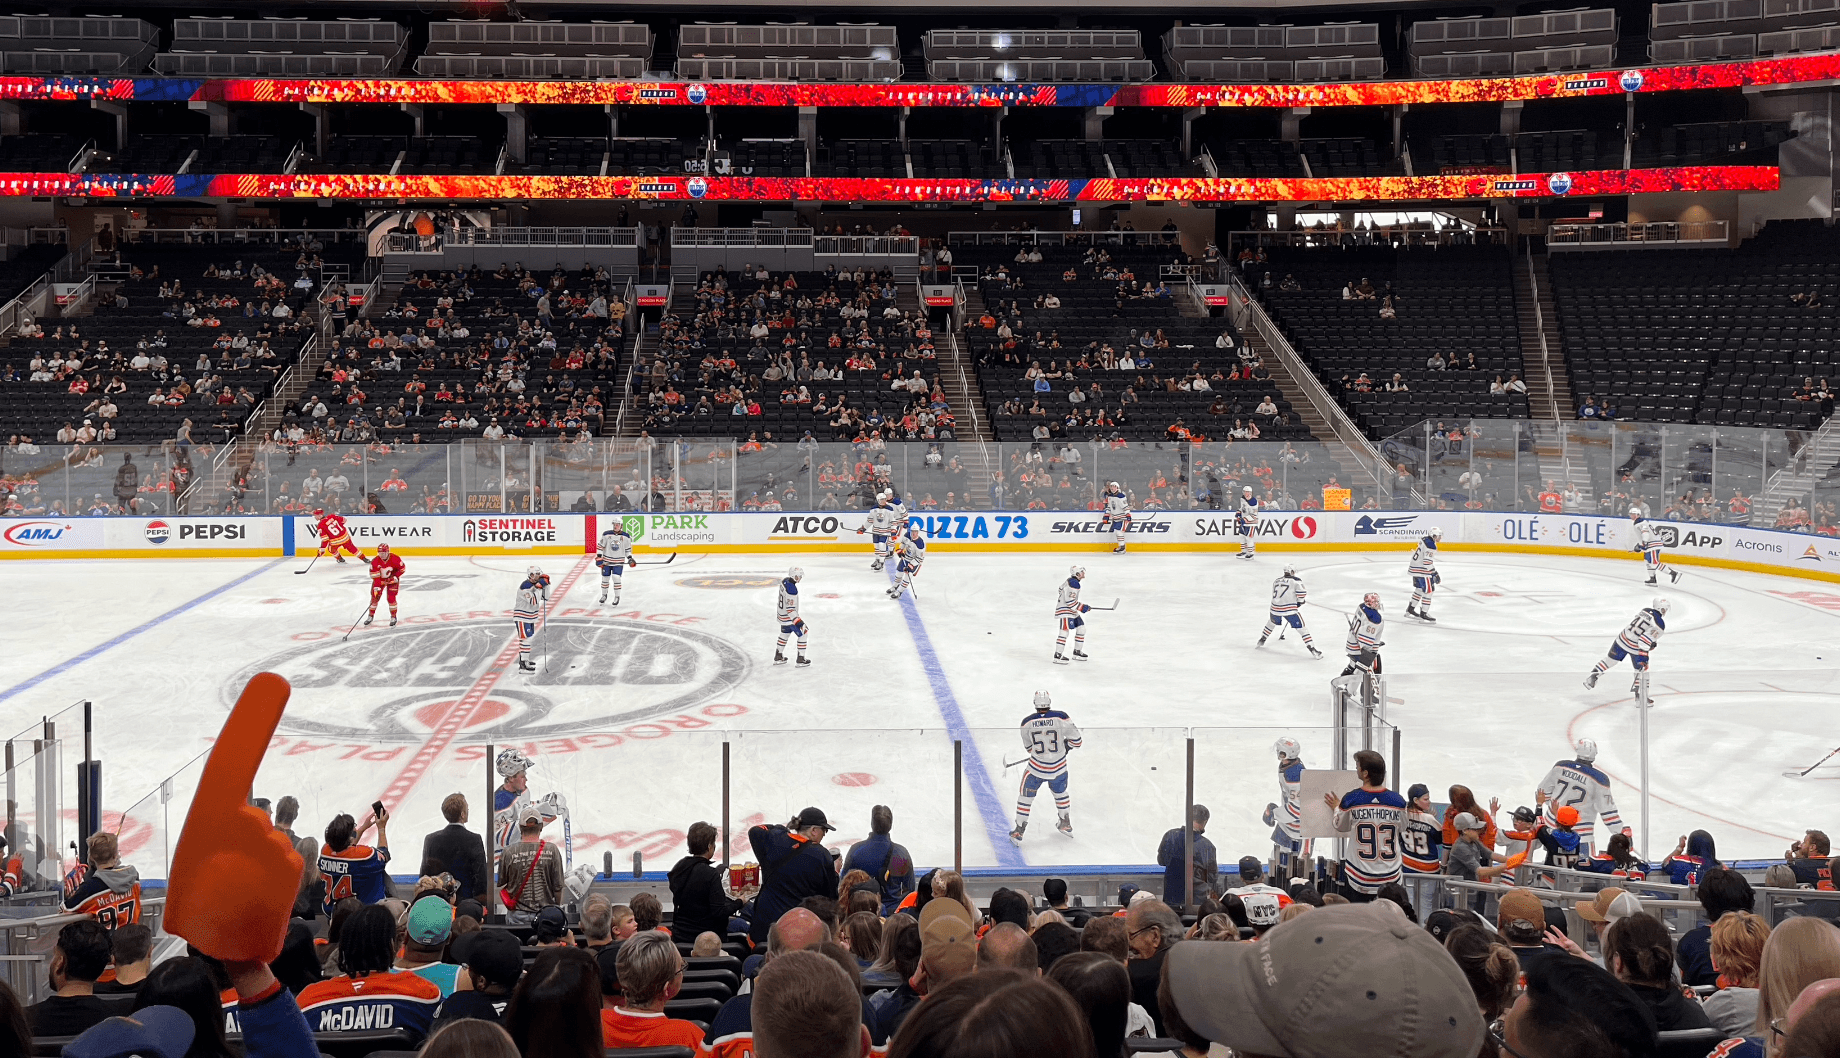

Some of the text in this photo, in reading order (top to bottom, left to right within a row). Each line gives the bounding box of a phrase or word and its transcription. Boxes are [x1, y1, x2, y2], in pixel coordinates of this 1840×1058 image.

[0, 84, 33, 92] TON
[327, 520, 345, 536] 67
[478, 518, 556, 530] SENTINEL
[651, 515, 708, 529] PARK
[772, 516, 839, 534] ATCO
[994, 515, 1029, 539] 73
[1503, 515, 1540, 541] OLÉ
[16, 528, 63, 540] AMJ
[179, 524, 246, 540] PEPSI
[349, 526, 432, 537] VELWEAR
[478, 530, 556, 542] STORAGE
[651, 531, 715, 543] Landscaping
[1568, 520, 1606, 545] OLÉ
[786, 598, 795, 606] 28
[1069, 591, 1076, 599] 22
[559, 607, 708, 626] PLACE
[1627, 616, 1651, 637] 45
[1032, 718, 1054, 728] HOWARD
[1031, 729, 1059, 755] 53
[1561, 768, 1588, 786] WOODALL
[1556, 778, 1587, 807] 72
[564, 821, 572, 860] BAUER
[1356, 822, 1398, 862] 93
[1401, 828, 1430, 855] 93
[320, 859, 349, 874] SKINNER
[96, 898, 136, 931] 97
[1253, 904, 1276, 918] NYC
[1260, 953, 1279, 987] FACE
[319, 1004, 394, 1032] McDAVID
